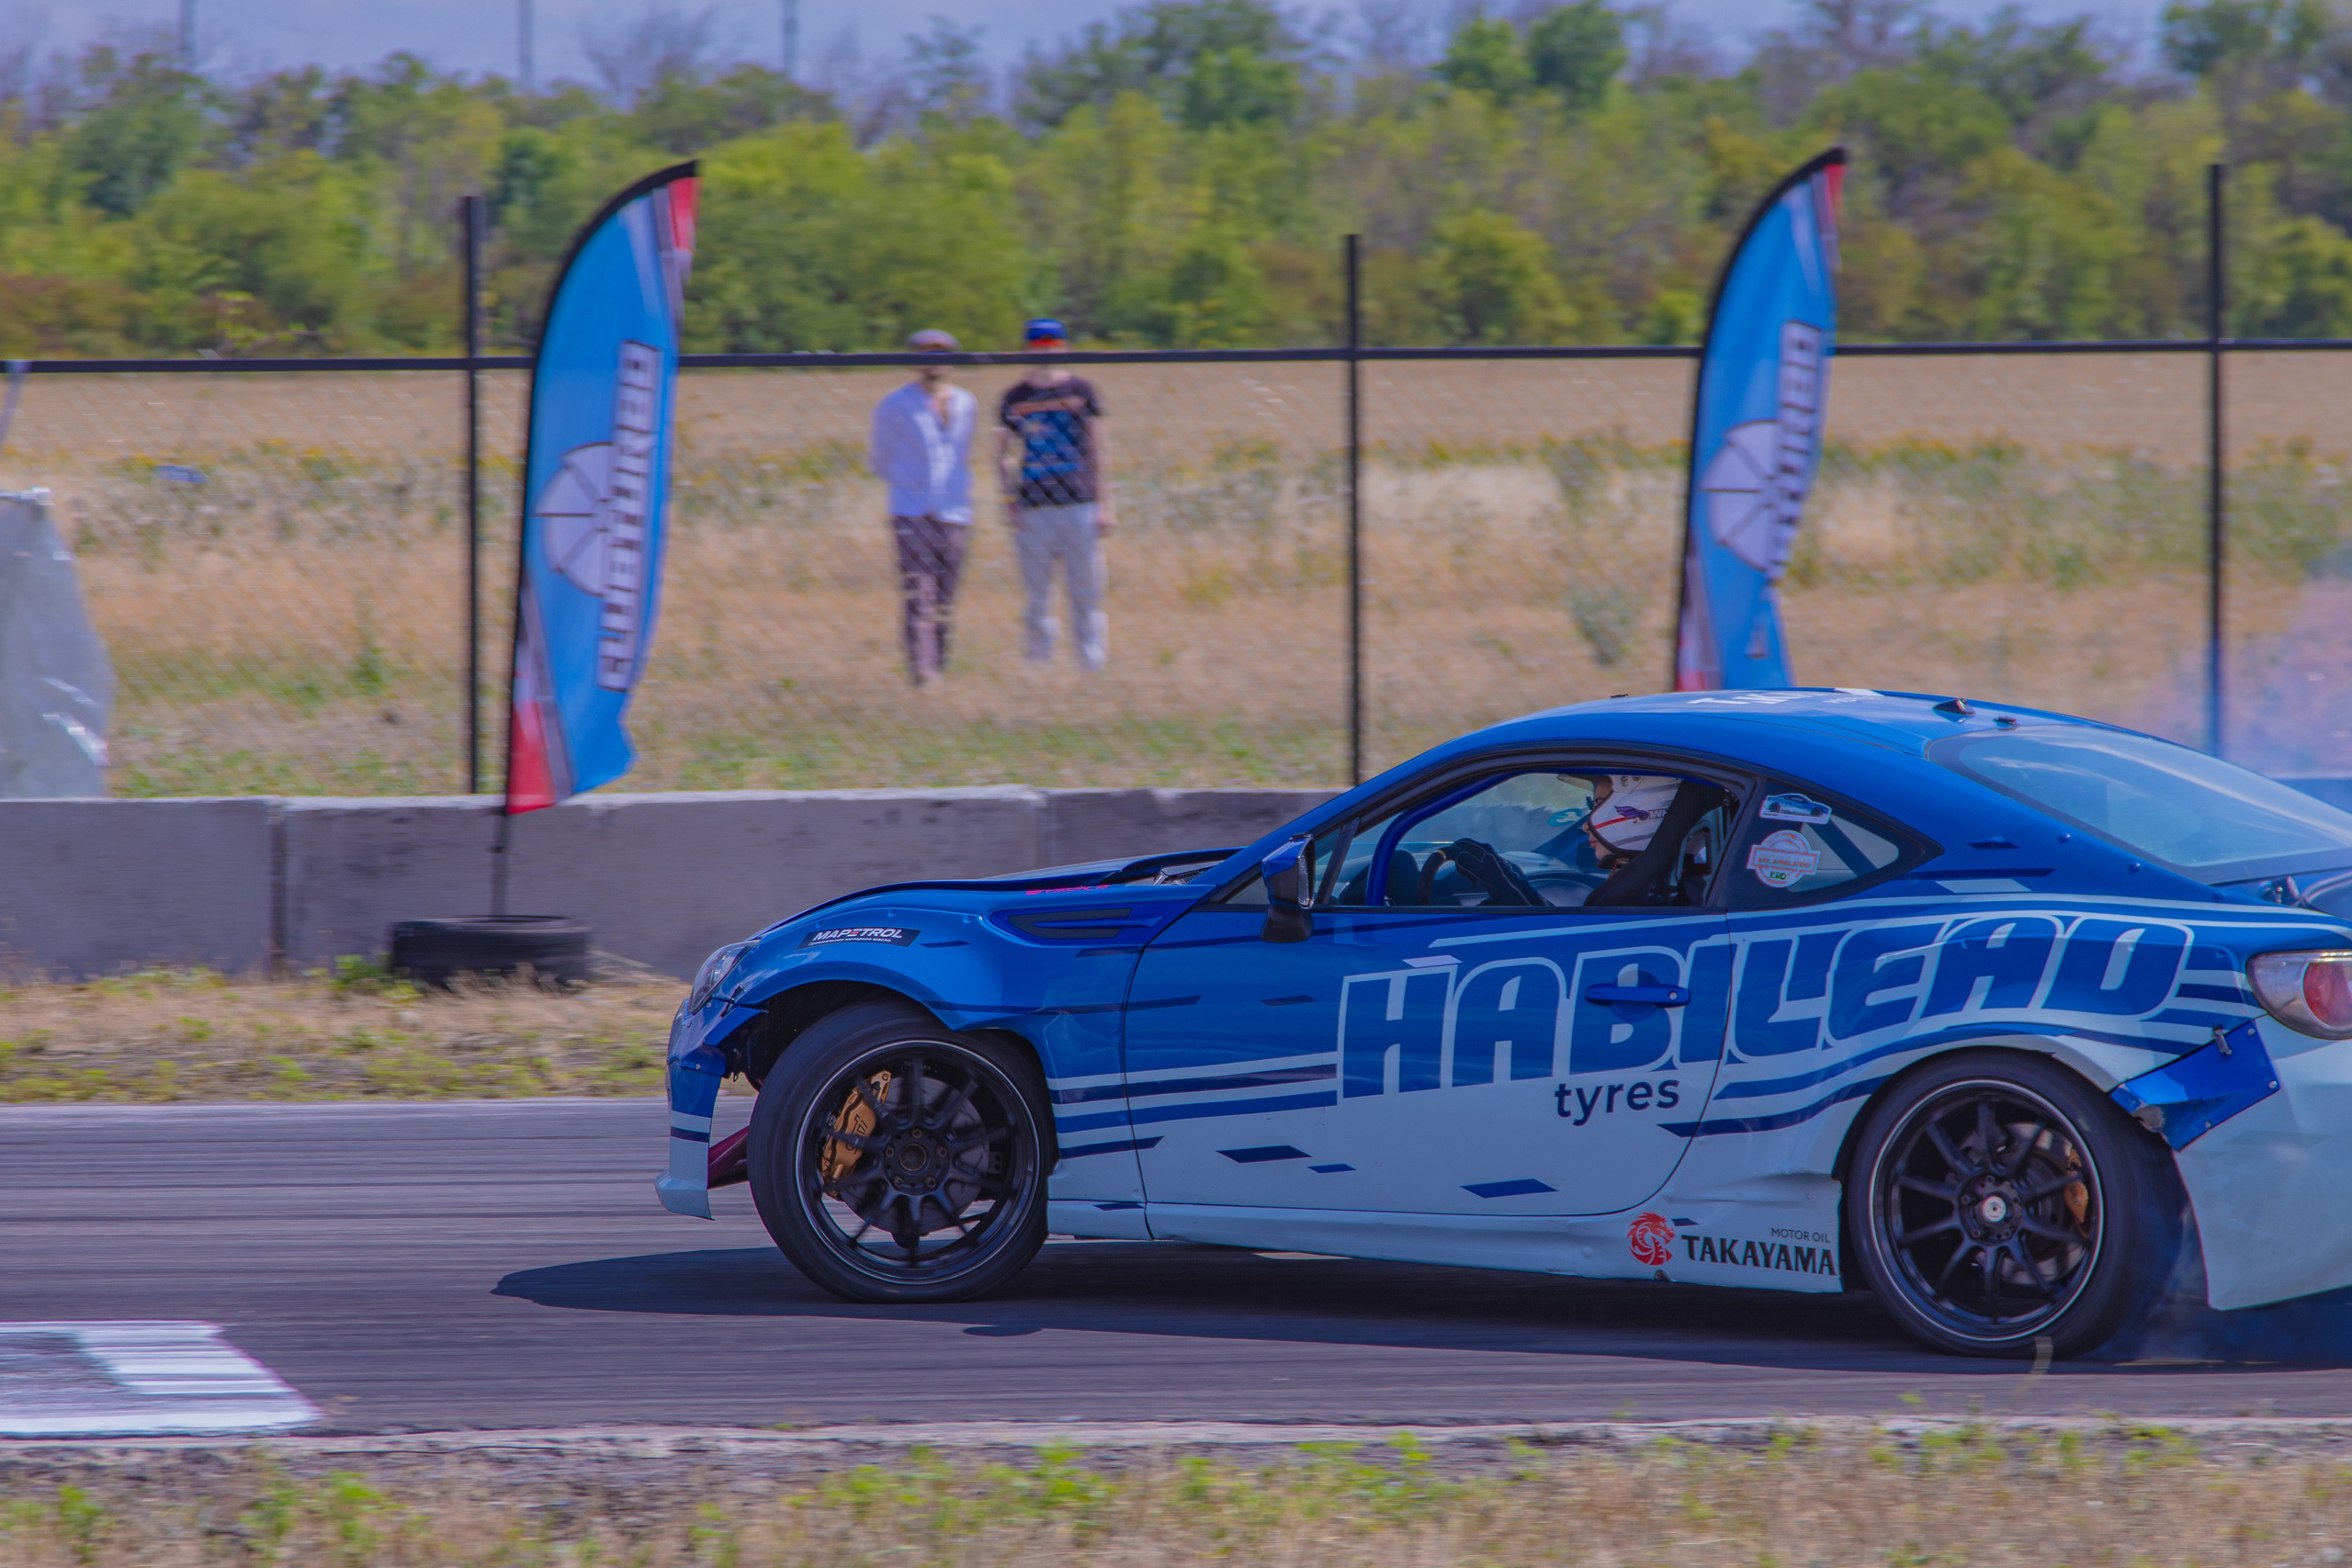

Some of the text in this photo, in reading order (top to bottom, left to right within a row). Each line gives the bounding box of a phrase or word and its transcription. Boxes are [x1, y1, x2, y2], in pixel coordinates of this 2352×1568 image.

[812, 928, 902, 941] MAPETROL
[1338, 909, 2196, 1101] HABILEAD
[1554, 1077, 1680, 1127] tyres
[1681, 1235, 1837, 1276] TAKAYAMA
[1770, 1227, 1831, 1244] MOTOR OIL
